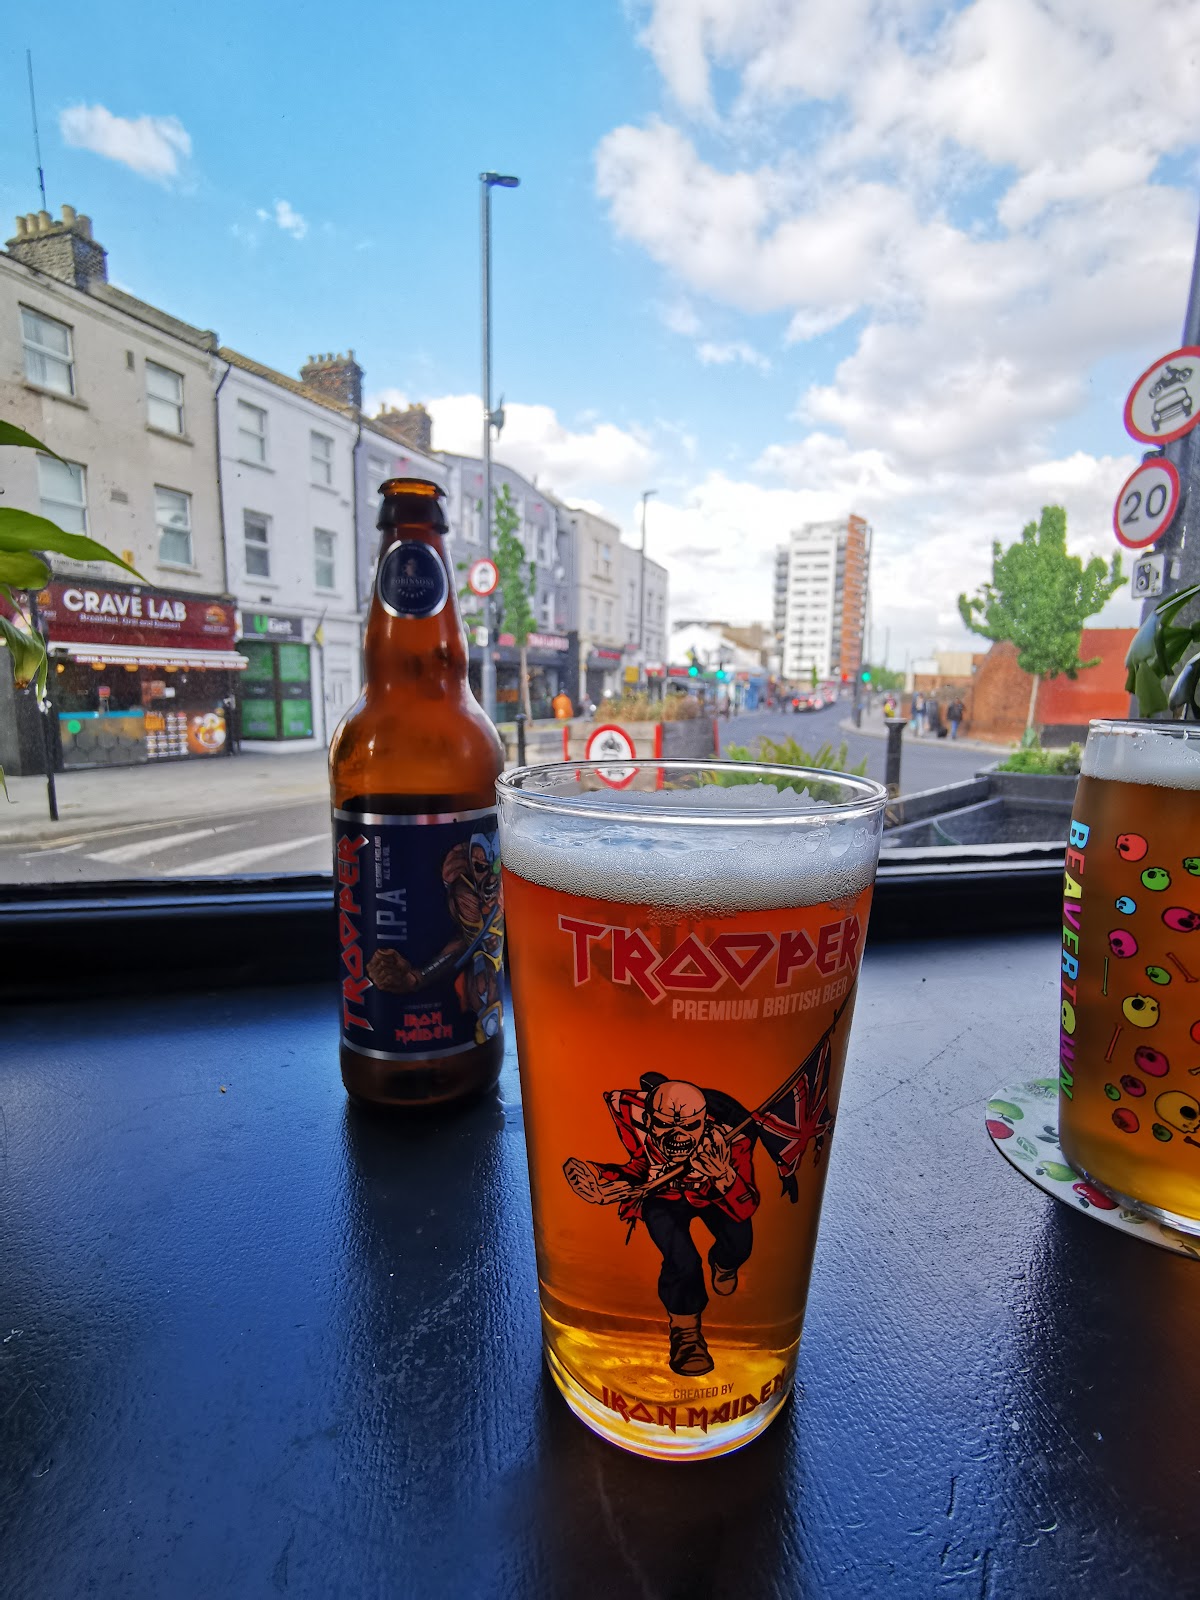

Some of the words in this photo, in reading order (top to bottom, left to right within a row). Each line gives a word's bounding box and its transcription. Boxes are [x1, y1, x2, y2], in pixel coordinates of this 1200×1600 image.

[1122, 484, 1168, 526] 20
[63, 589, 143, 617] CRAVE
[148, 598, 187, 621] LAB
[337, 834, 374, 1031] TROOPER
[558, 911, 861, 1006] TROOPER
[1059, 819, 1090, 1101] BEAVERTOWN
[672, 998, 759, 1021] PREMIUM
[763, 987, 820, 1018] BRITISH
[823, 975, 848, 1004] BEER
[601, 1385, 677, 1435] IRON
[685, 1366, 787, 1435] MAIDEN
[673, 1386, 719, 1399] CREATED
[720, 1382, 735, 1396] BY
